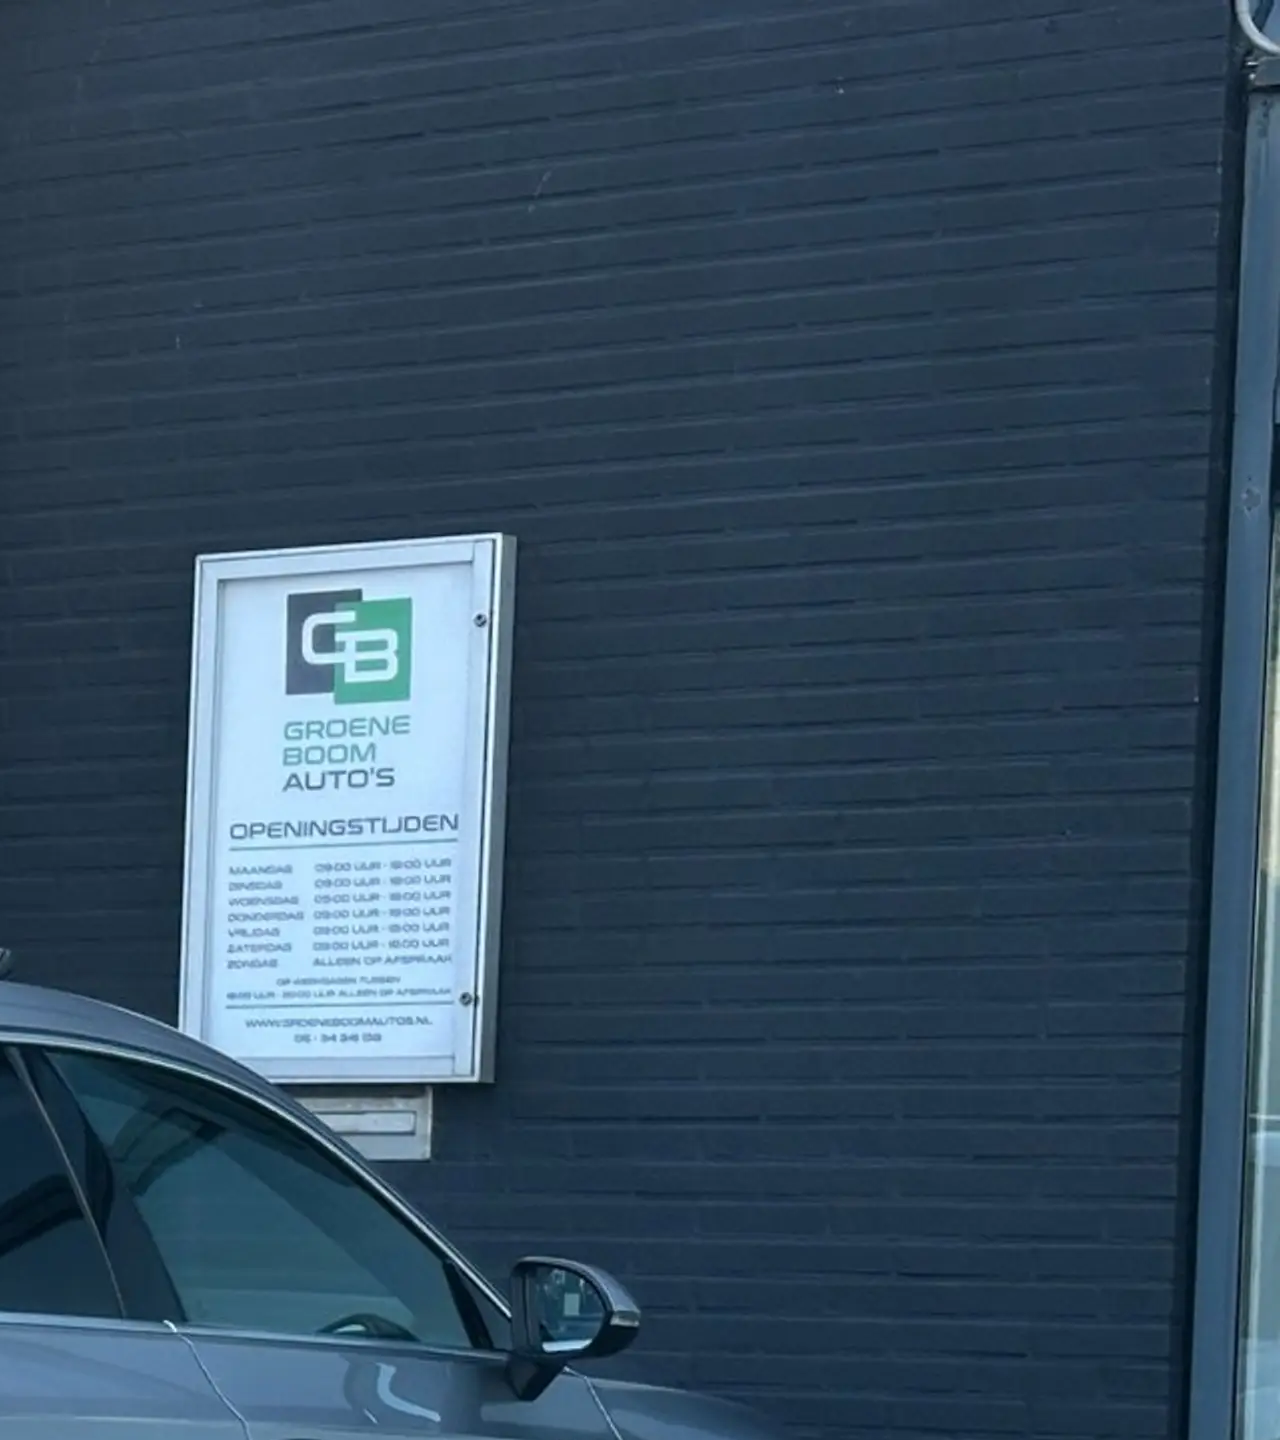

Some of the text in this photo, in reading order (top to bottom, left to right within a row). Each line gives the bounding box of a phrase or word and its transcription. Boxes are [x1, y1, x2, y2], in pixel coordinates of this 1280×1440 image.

[284, 714, 411, 740] GROENE
[282, 741, 376, 766] BOOM
[282, 767, 395, 792] AUTO'S
[229, 813, 459, 840] OPENINGSTIJDEN
